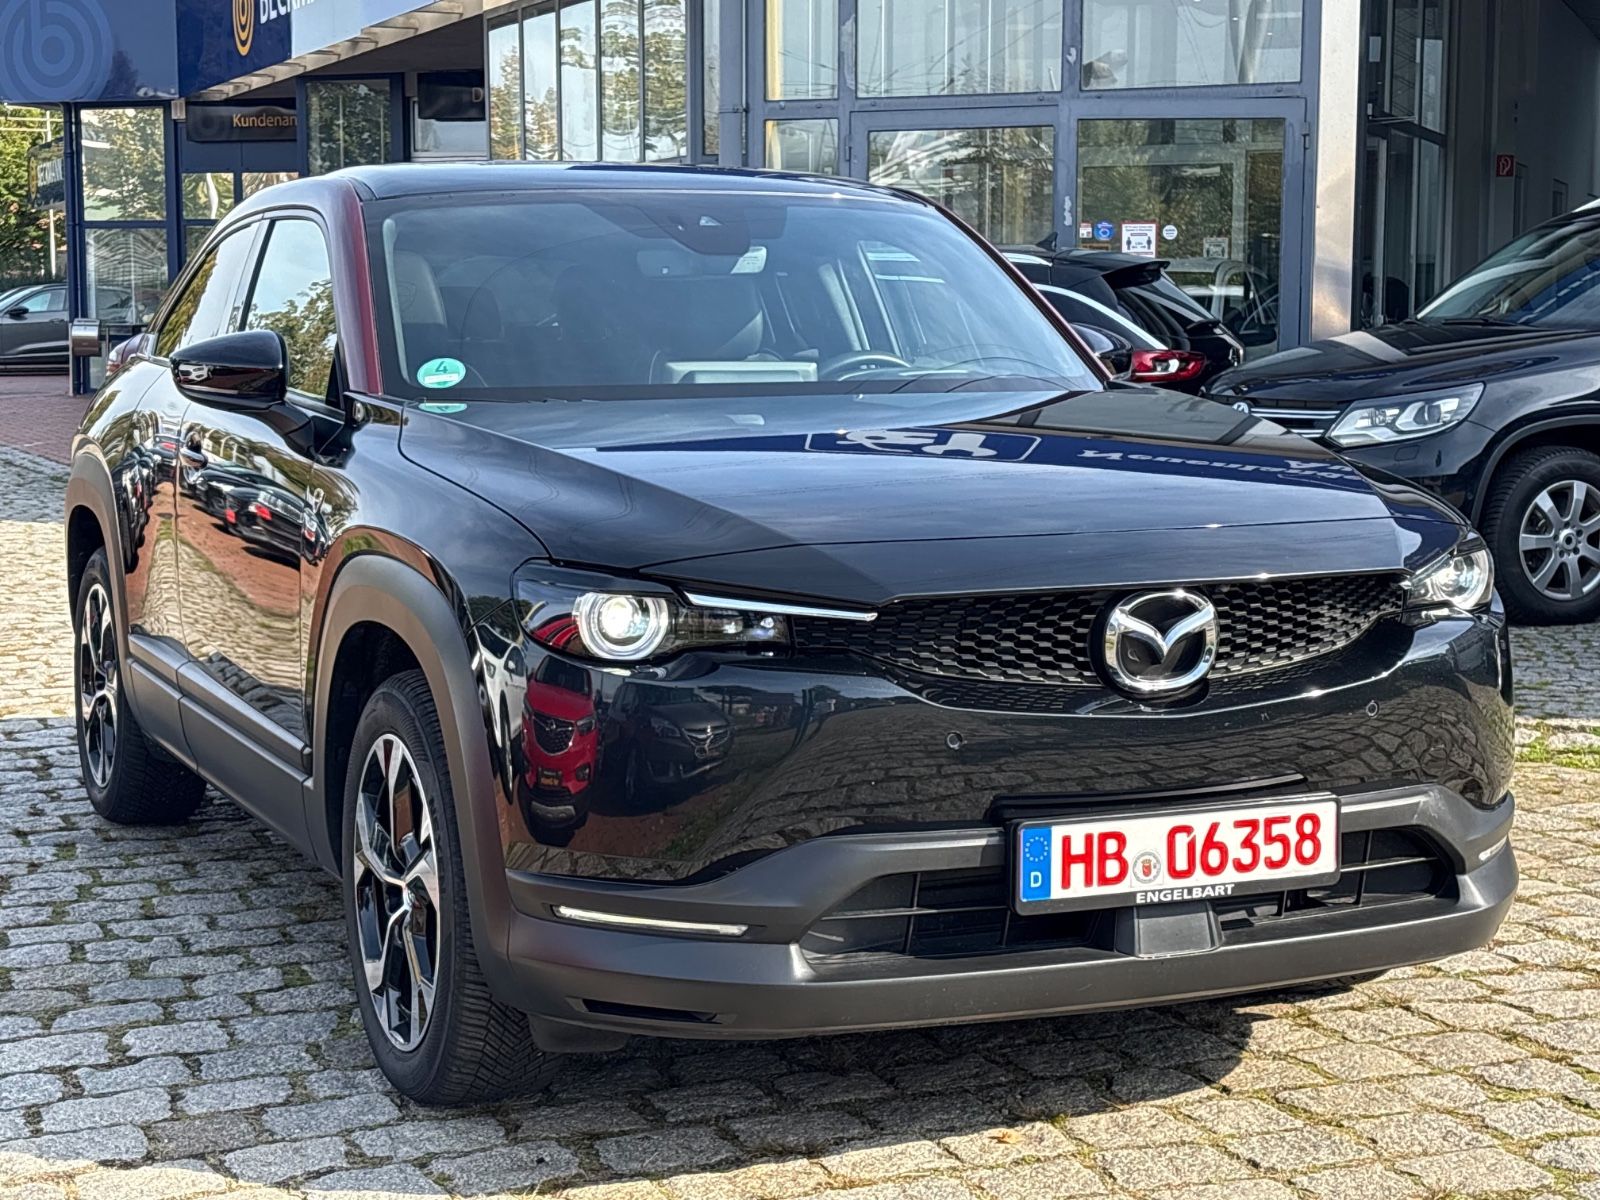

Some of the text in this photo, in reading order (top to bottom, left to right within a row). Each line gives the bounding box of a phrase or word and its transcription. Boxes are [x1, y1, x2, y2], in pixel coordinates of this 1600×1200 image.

[435, 360, 449, 374] 4
[1061, 831, 1129, 889] HB
[1166, 813, 1322, 879] 06358
[1030, 871, 1042, 888] D
[1136, 883, 1235, 904] ENGELBART
